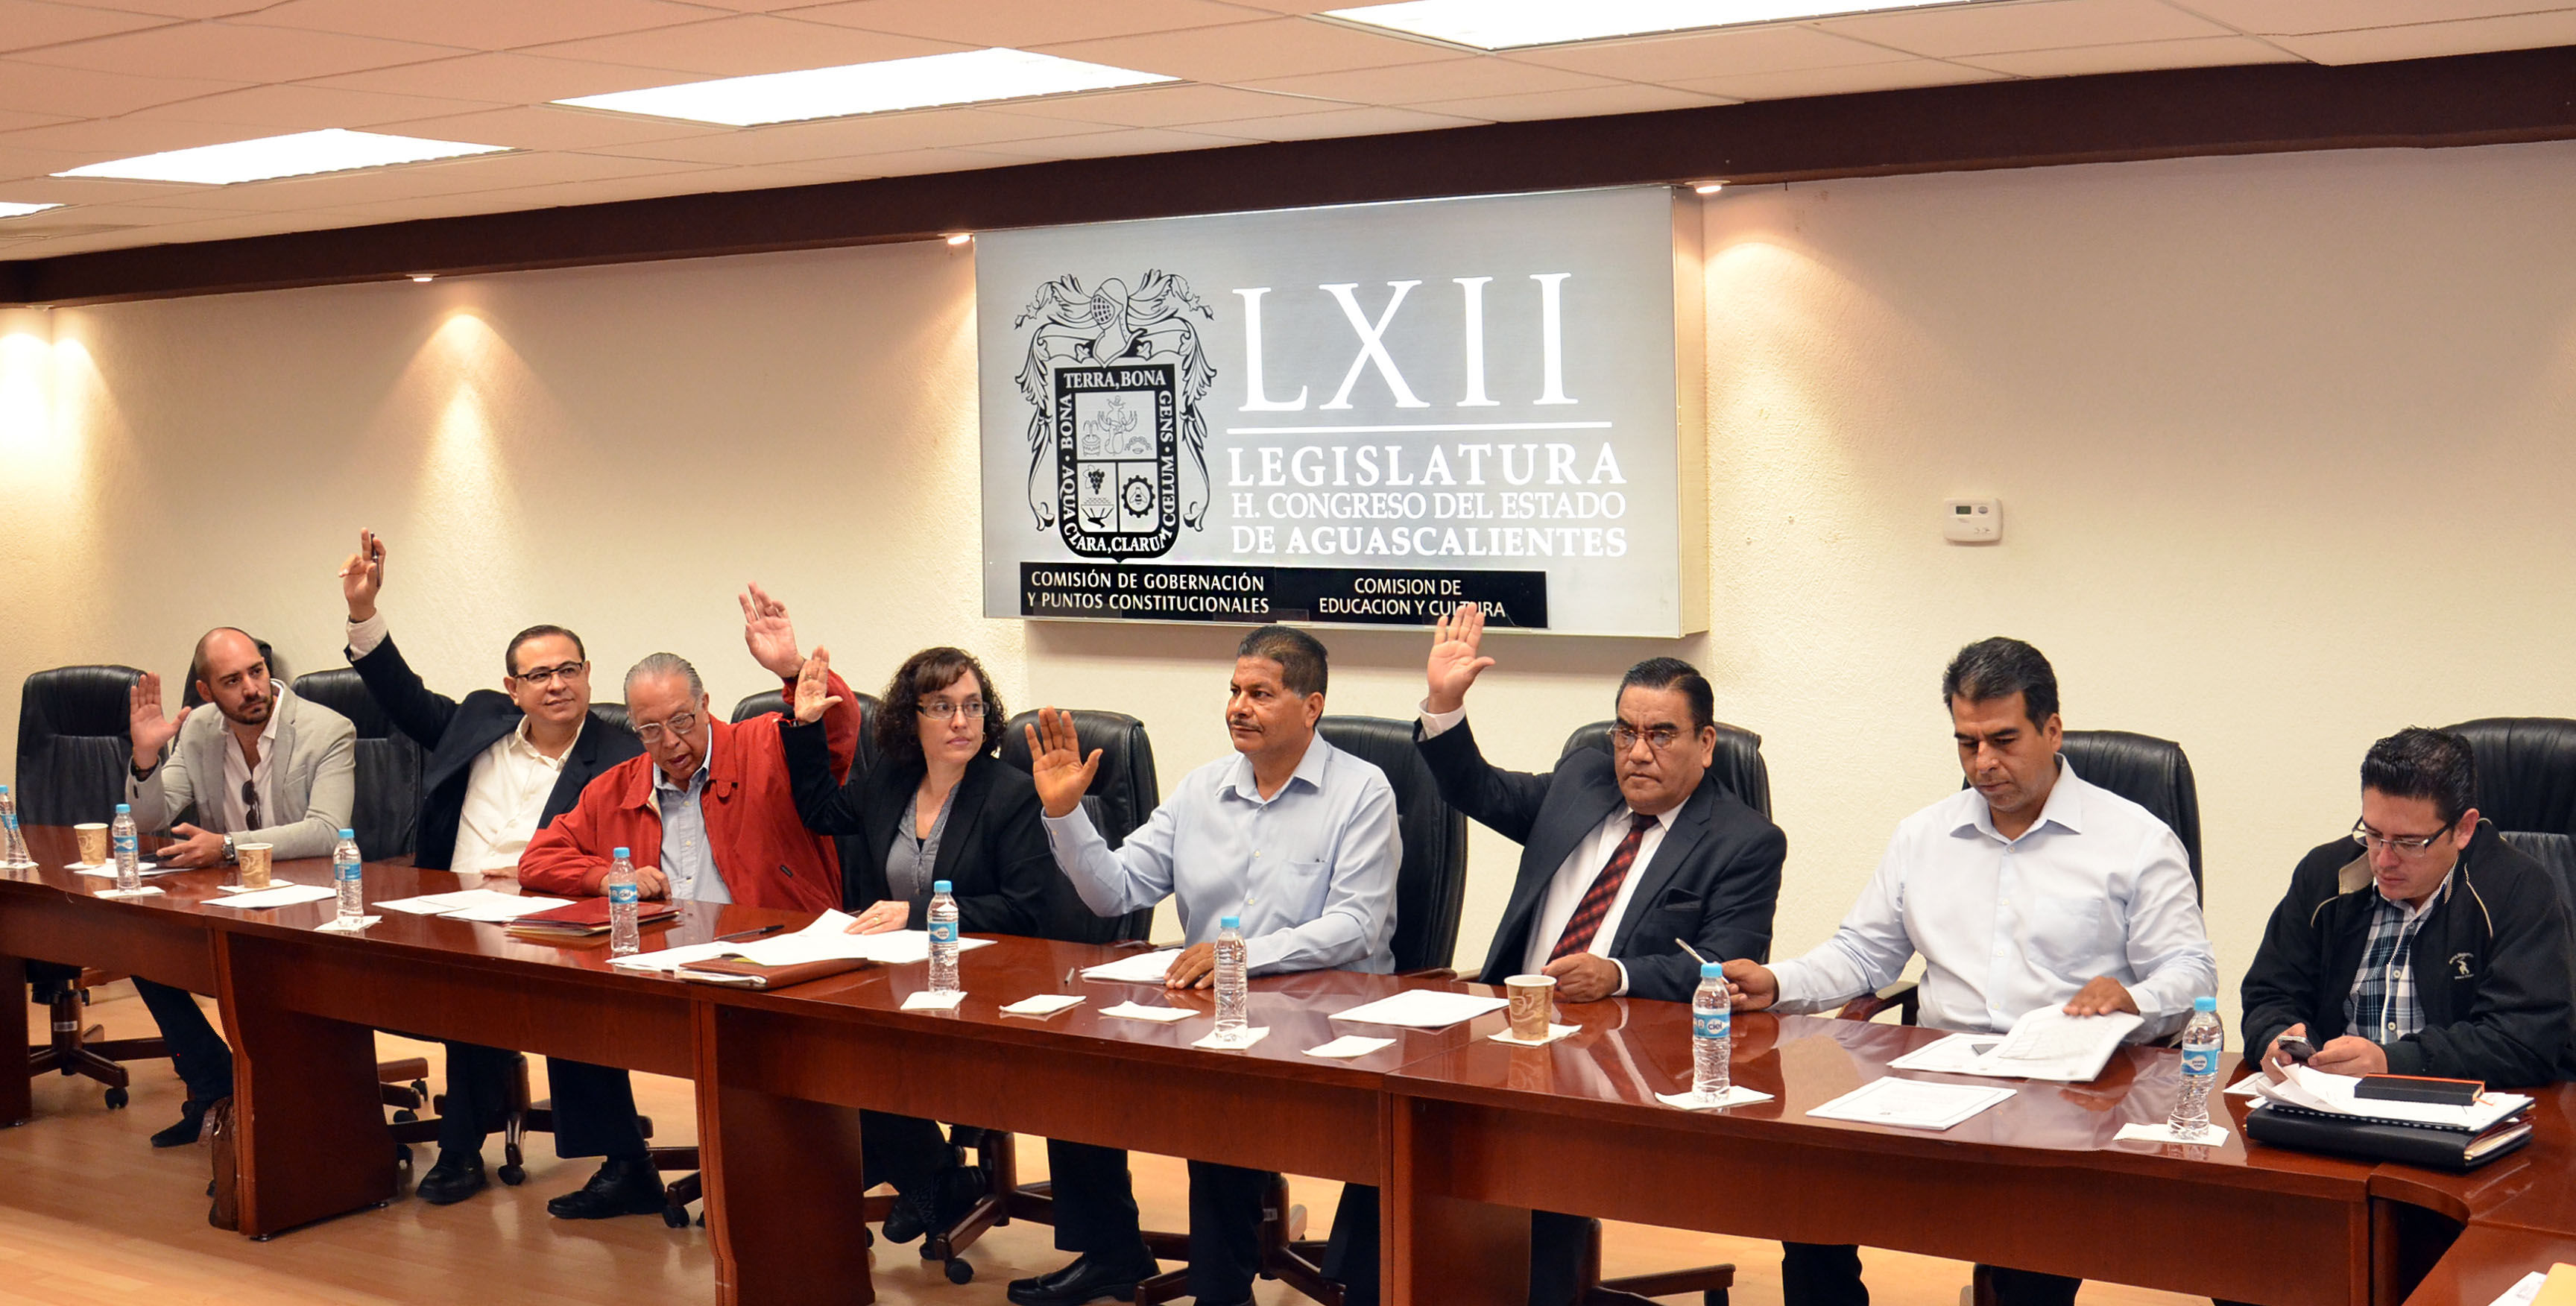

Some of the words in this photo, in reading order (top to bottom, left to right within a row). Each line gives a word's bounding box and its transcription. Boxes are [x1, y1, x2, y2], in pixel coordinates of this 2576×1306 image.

[1232, 272, 1579, 411] LXII
[1121, 370, 1167, 387] BONA
[1059, 394, 1073, 450] BONA
[1159, 390, 1173, 443] GENS
[1228, 442, 1627, 487] LEGISLATURA
[1060, 465, 1076, 520] AQUA
[1231, 493, 1260, 519] H.
[1267, 492, 1426, 519] CONGRESO
[1433, 492, 1494, 518] DEL
[1500, 491, 1626, 519] ESTADO
[1111, 527, 1172, 552] CLARUM
[1232, 526, 1275, 553] DE
[1286, 526, 1627, 557] AGUASCALIENTES
[1031, 570, 1111, 587] COMISIÓN
[1118, 573, 1137, 589] DE
[1144, 572, 1264, 591] GOBERNACIÓN
[1354, 578, 1436, 595] COMISION
[1441, 579, 1462, 595] DE
[1028, 593, 1035, 607] Y
[1042, 593, 1103, 608] PUNTOS
[1109, 595, 1269, 613] CONSTITUCIONALES
[1319, 598, 1411, 615] EDUCACION
[1414, 600, 1425, 615] Y
